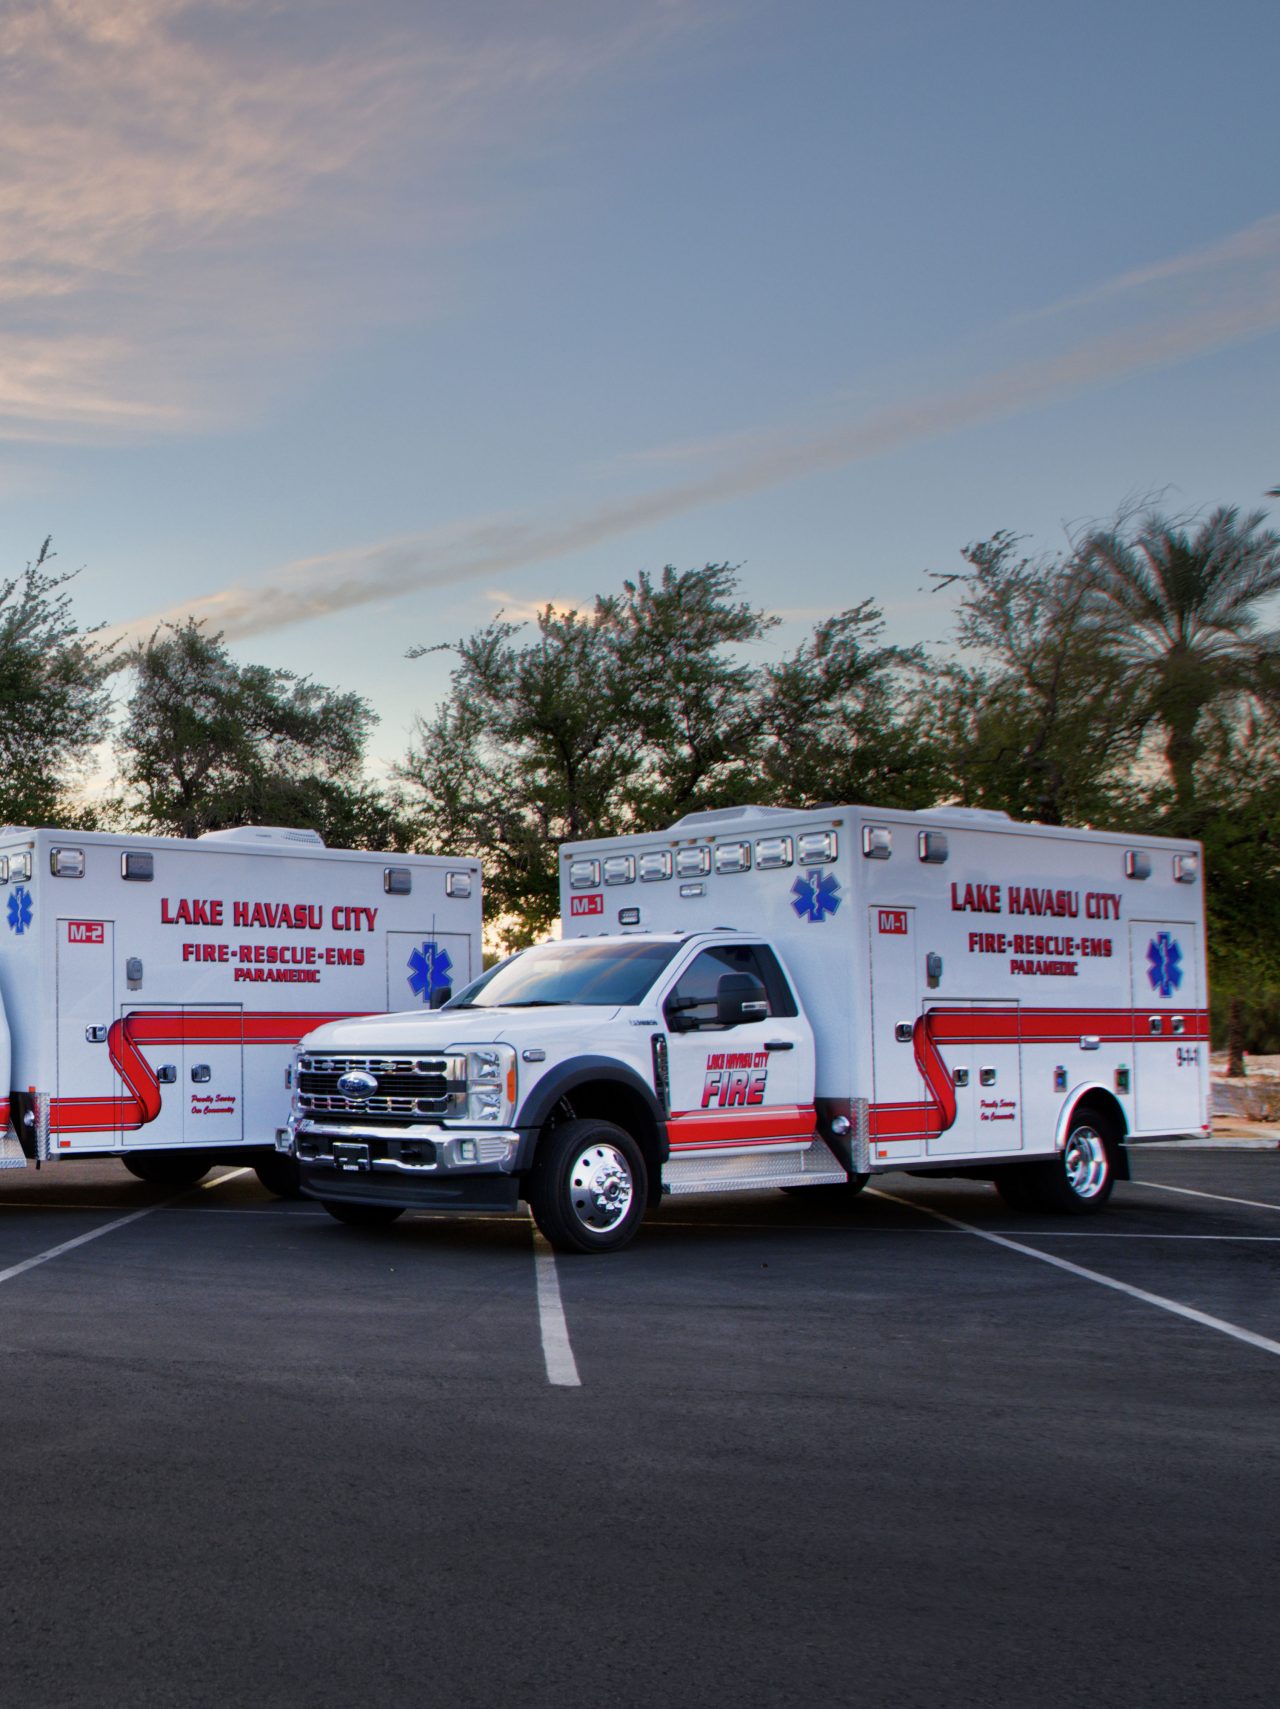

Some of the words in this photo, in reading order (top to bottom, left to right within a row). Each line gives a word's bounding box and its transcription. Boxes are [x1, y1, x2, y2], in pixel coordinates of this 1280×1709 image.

[573, 897, 601, 913] M-1
[951, 882, 1002, 913] LAKE
[1008, 886, 1079, 918] HAVASU
[1085, 891, 1122, 920] CITY
[161, 898, 223, 926] LAKE
[233, 901, 322, 930] HAVASU
[332, 905, 379, 932] CITY
[880, 913, 905, 931] M-1
[70, 925, 102, 941] M-2
[234, 968, 321, 983] PARAMEDIC
[1010, 959, 1078, 976] PARAMEDIC
[706, 1053, 725, 1070] LAKE
[725, 1052, 753, 1069] HAVASU
[754, 1052, 769, 1068] CITY
[701, 1069, 768, 1108] FIRE
